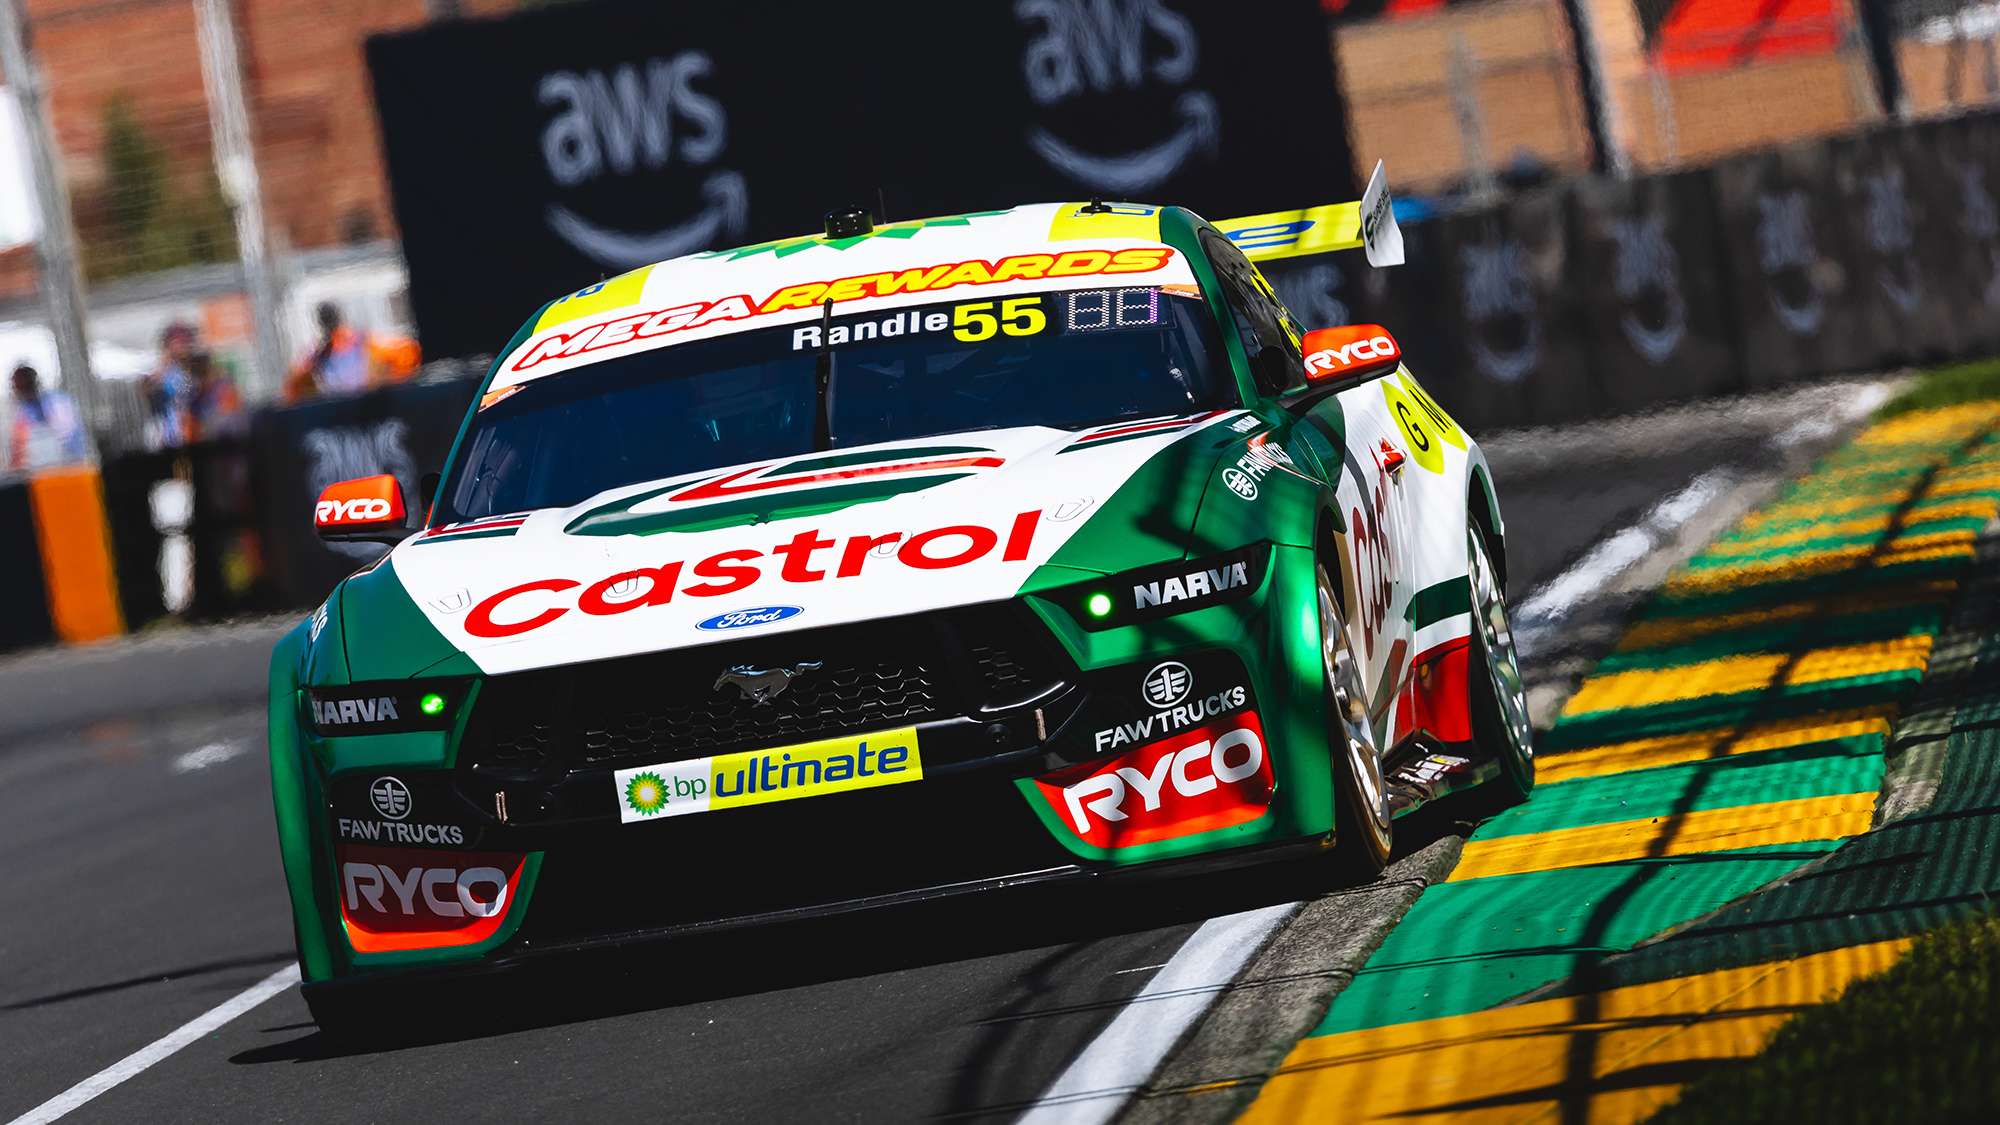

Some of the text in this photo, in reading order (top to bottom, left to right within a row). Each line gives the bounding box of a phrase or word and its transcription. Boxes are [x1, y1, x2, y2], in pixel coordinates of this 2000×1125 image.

[538, 50, 728, 186] aws
[758, 247, 1174, 316] REWARDS
[792, 296, 1047, 351] Randle 55
[1303, 335, 1397, 376] RYCO
[315, 498, 392, 523] RYCO
[463, 510, 1043, 638] Castrol
[1135, 563, 1247, 609] NARVA
[720, 606, 780, 628] Ford
[1094, 687, 1245, 753] FAW TRUCKS
[673, 738, 909, 799] bp ultimate
[1064, 729, 1262, 834] RYCO
[338, 818, 464, 846] FAW TRUCKS
[342, 862, 508, 918] RYCO
